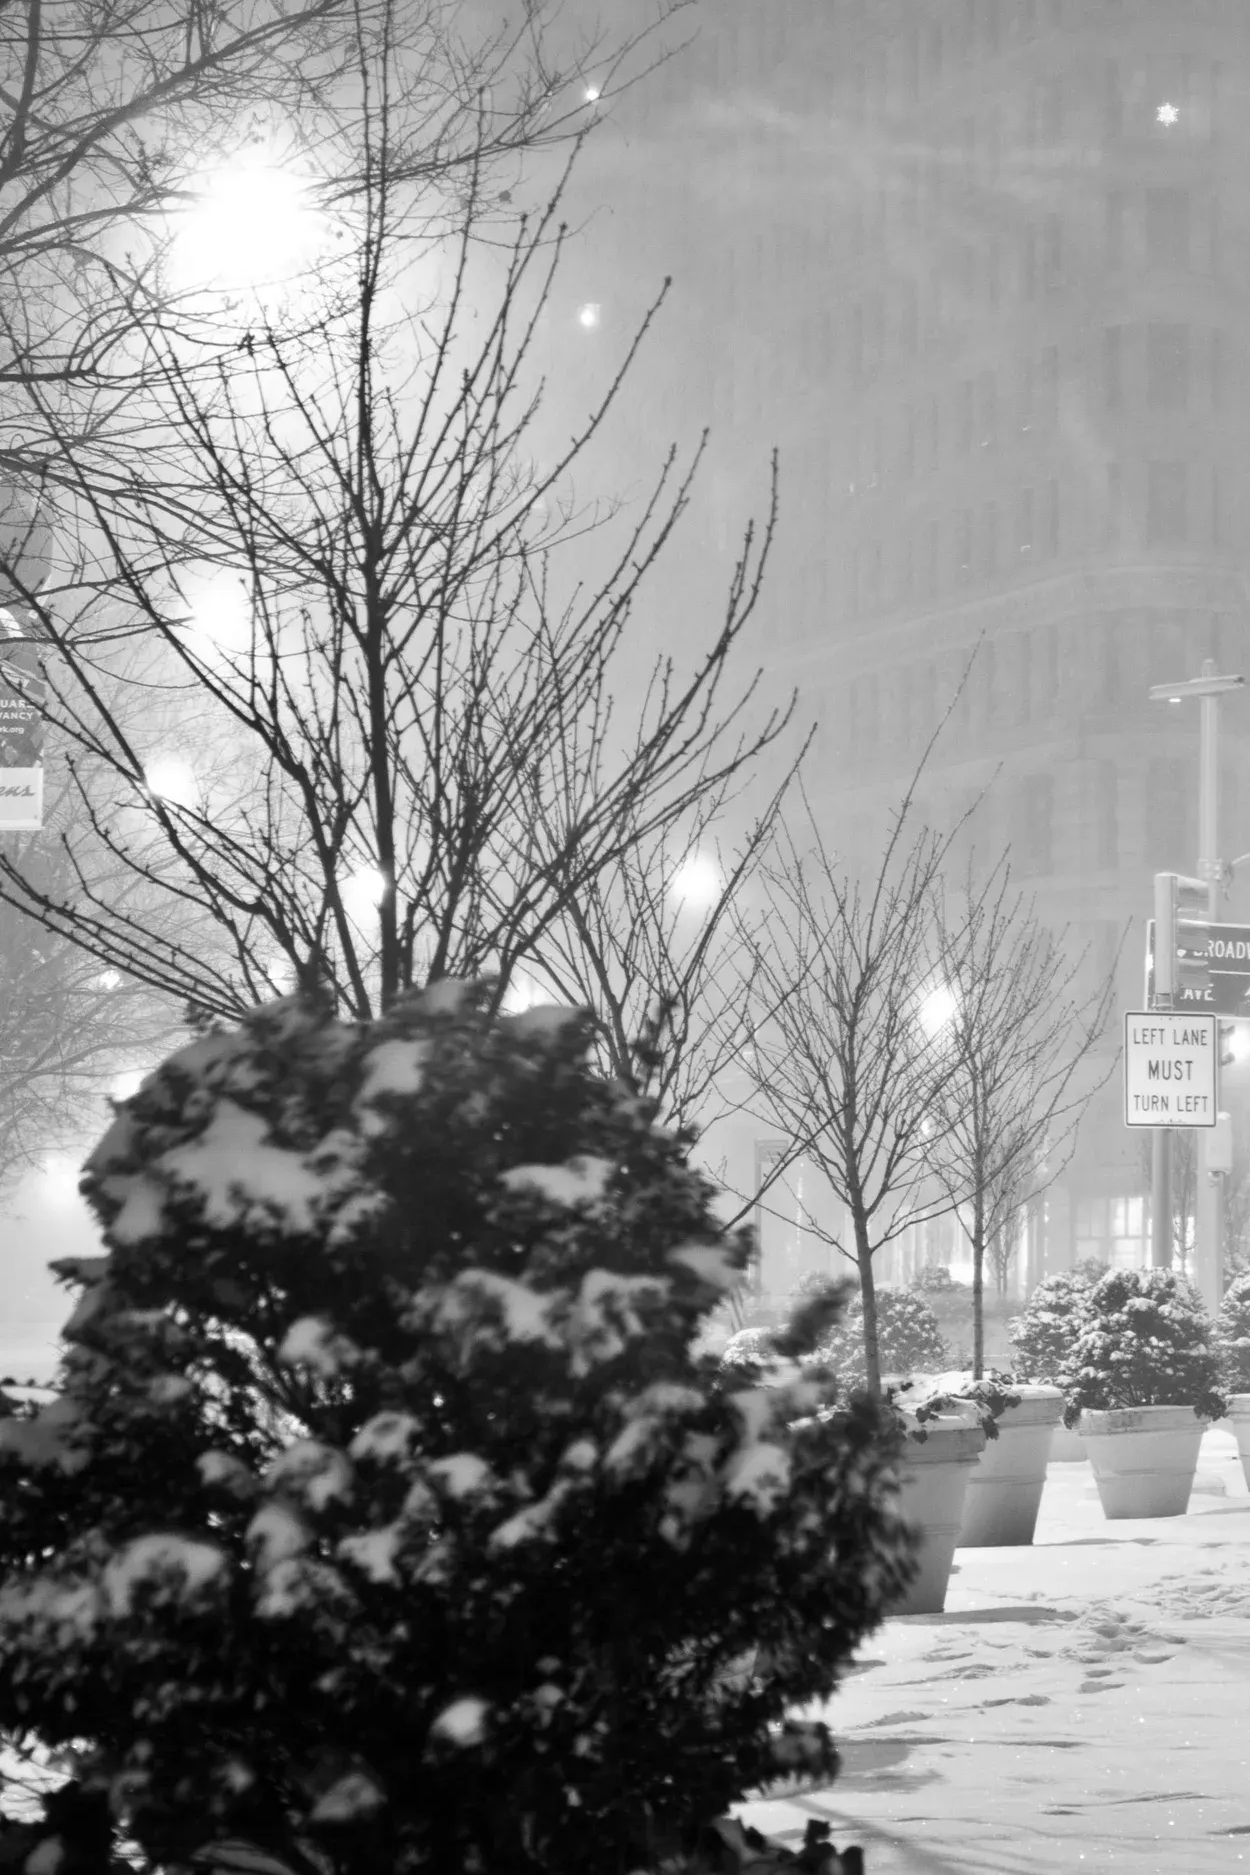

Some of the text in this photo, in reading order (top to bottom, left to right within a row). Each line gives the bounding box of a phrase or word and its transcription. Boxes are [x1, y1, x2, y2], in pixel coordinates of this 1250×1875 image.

[0, 699, 35, 708] UAR
[1133, 1028, 1208, 1046] LEFT LANE
[1148, 1060, 1193, 1081] MUST
[1133, 1094, 1208, 1113] TURN LEFT
